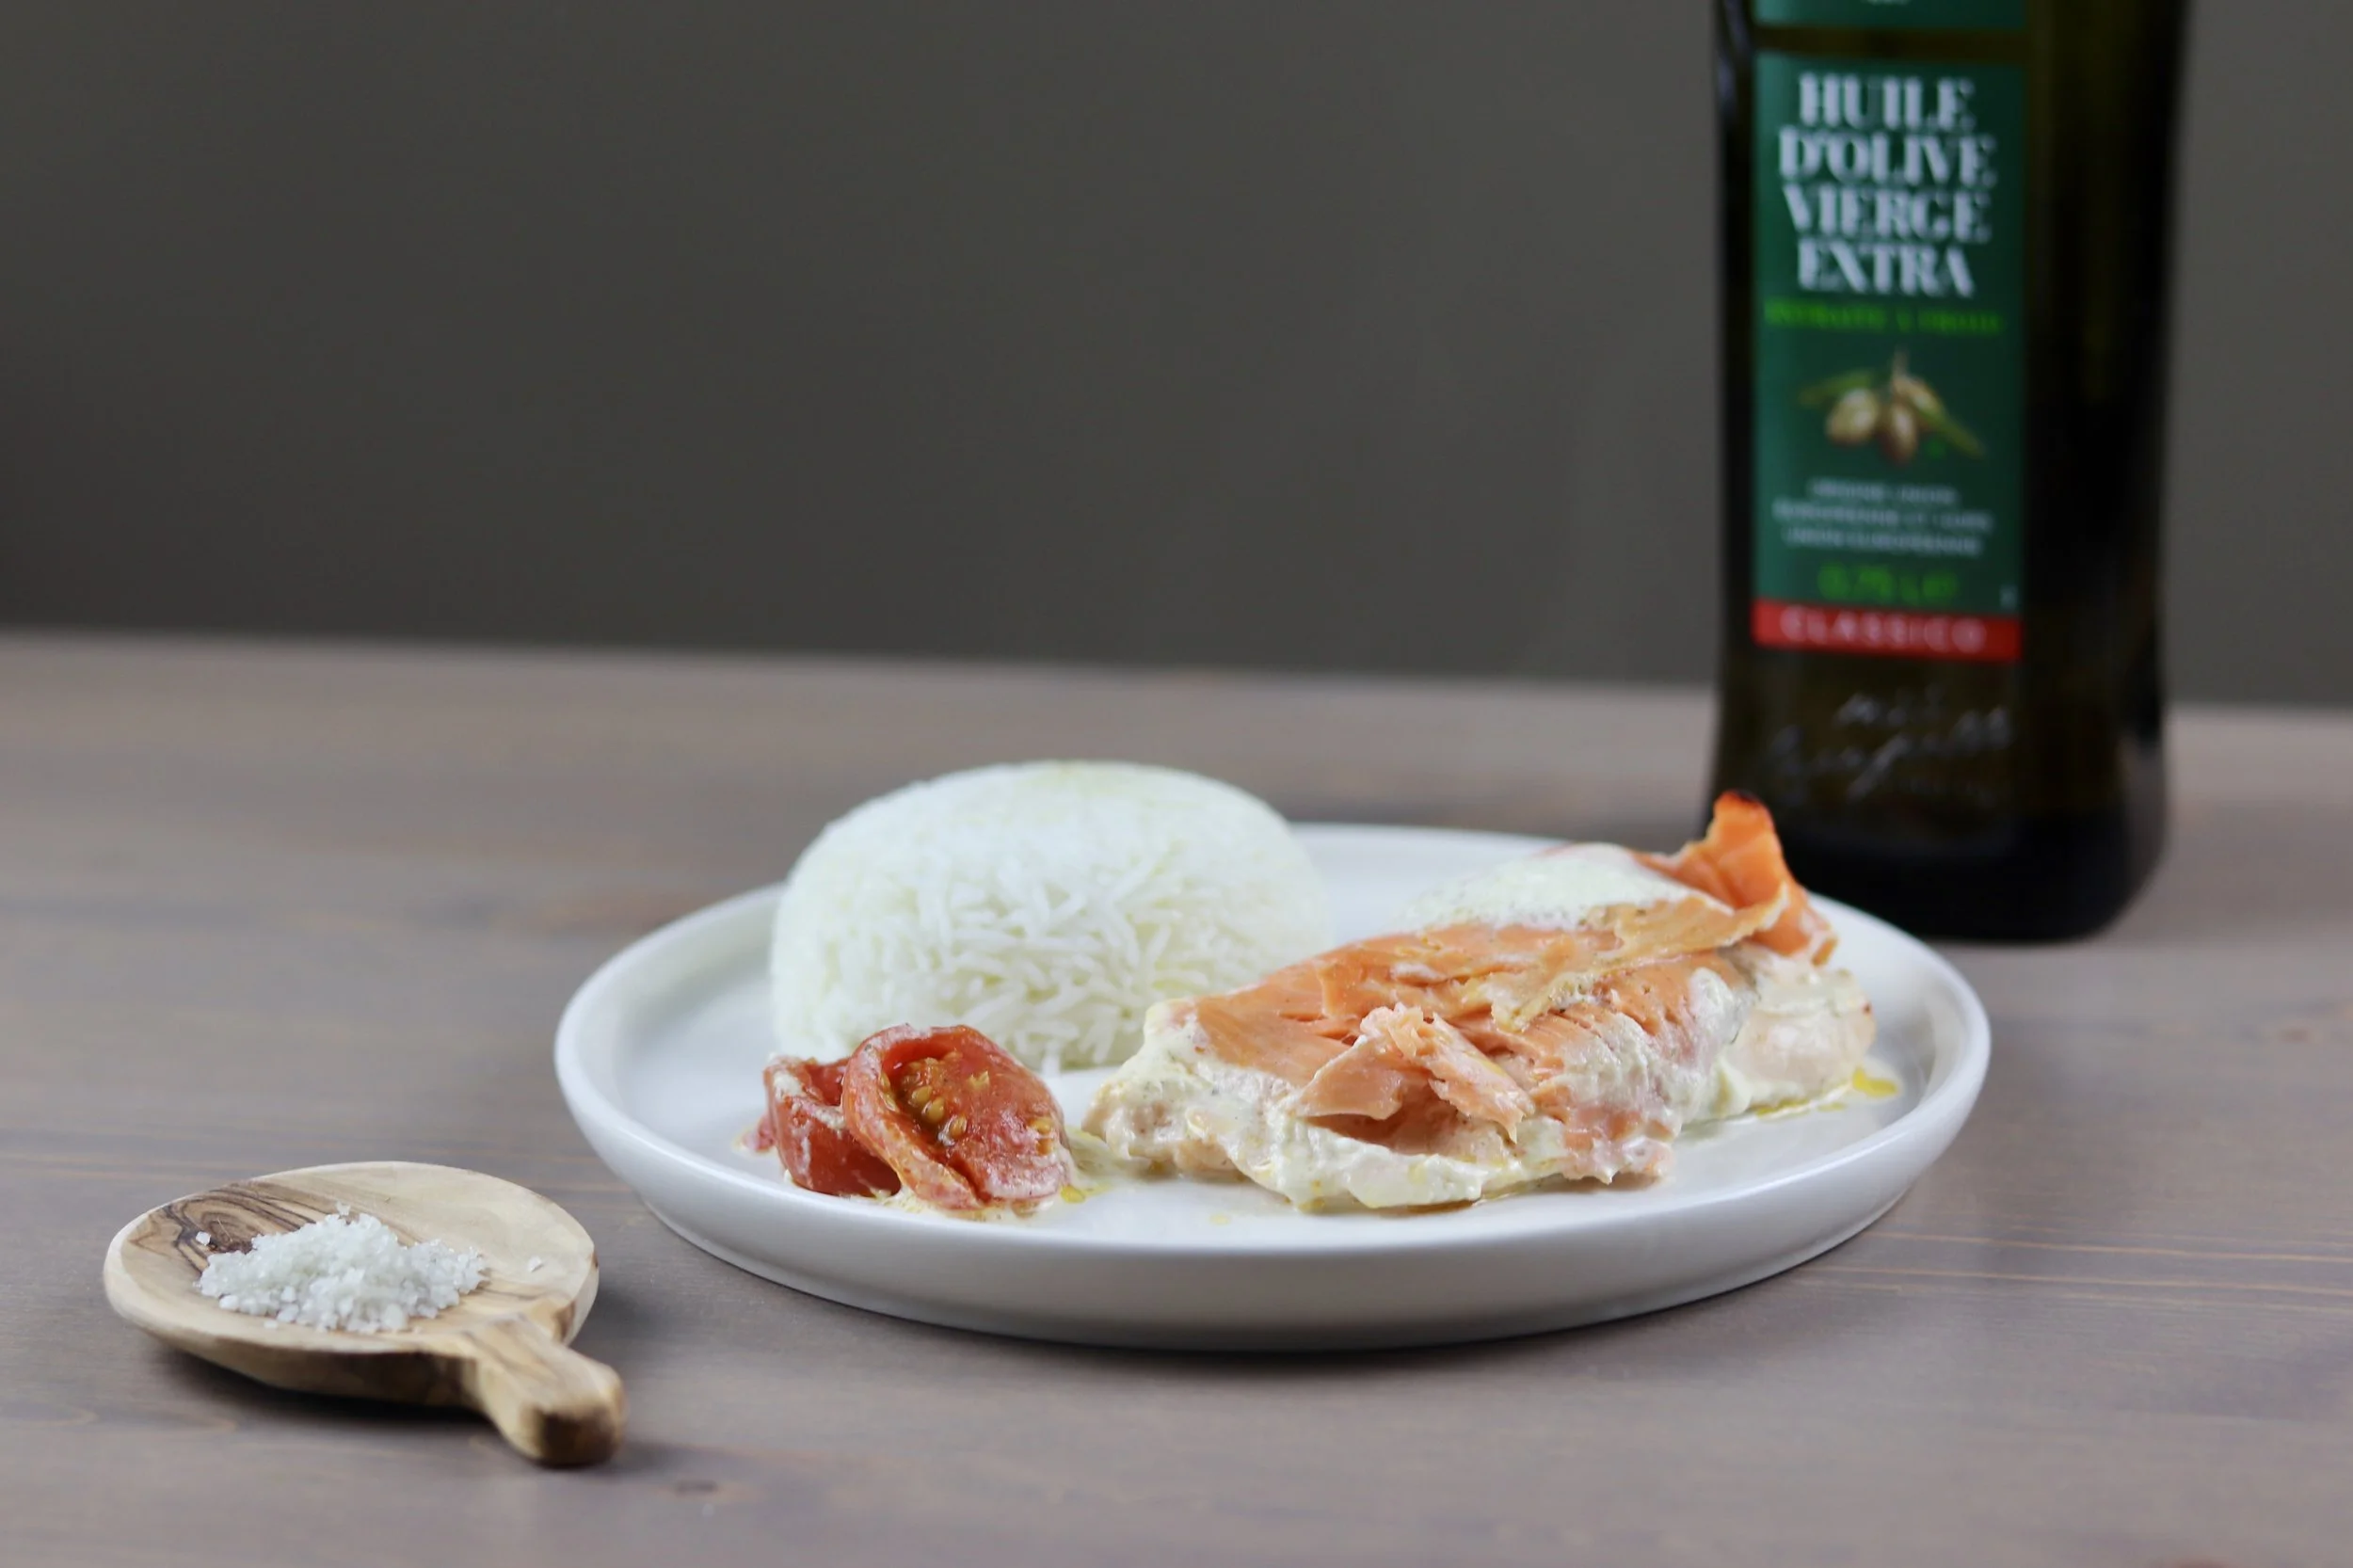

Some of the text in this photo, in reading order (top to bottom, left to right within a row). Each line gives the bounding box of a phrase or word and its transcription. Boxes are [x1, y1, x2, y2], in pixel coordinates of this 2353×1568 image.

[1799, 72, 1975, 131] HUILE
[1783, 183, 1992, 243] VIERGE
[1798, 236, 1974, 298] EXTRA
[1780, 603, 1988, 653] CLASSICO
